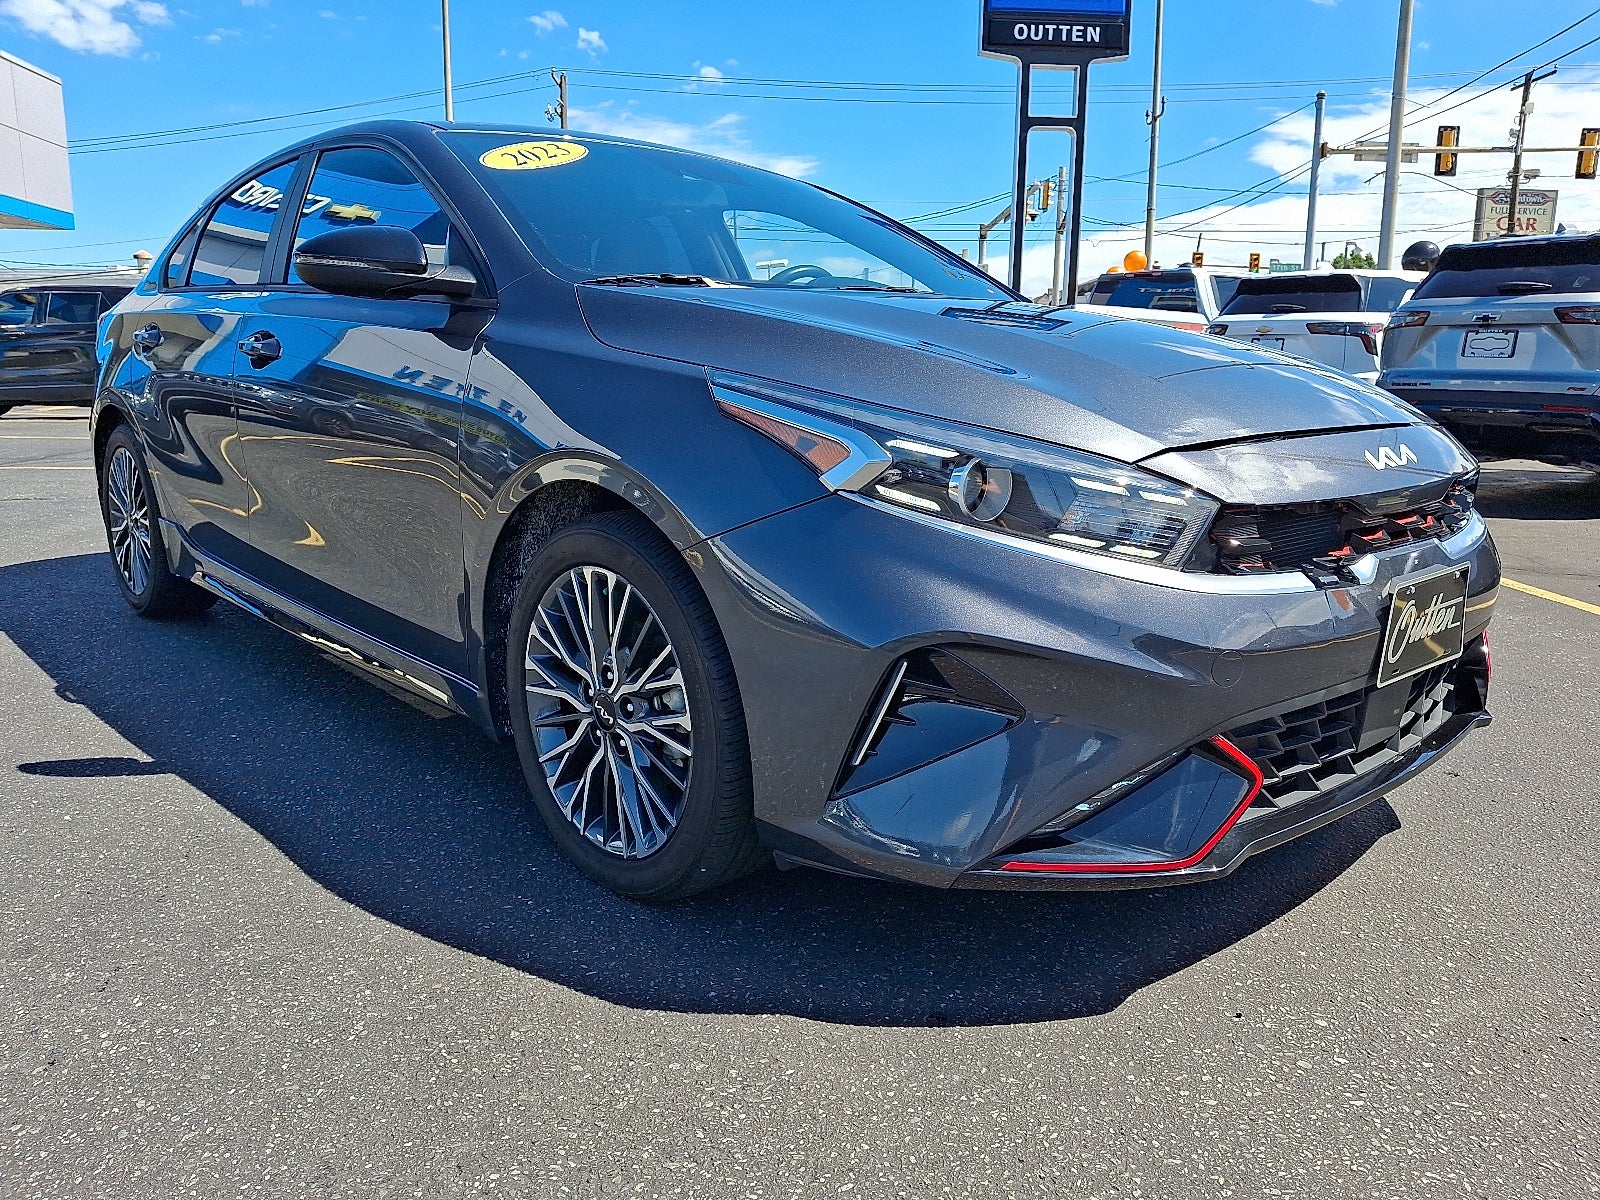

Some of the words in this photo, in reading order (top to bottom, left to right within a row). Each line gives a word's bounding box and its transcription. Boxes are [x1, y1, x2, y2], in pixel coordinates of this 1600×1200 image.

[1013, 23, 1101, 43] OUTTEN
[501, 143, 571, 166] 2023
[1516, 207, 1548, 215] ERVICE
[1496, 216, 1538, 231] CAR
[1388, 592, 1464, 664] Outten
